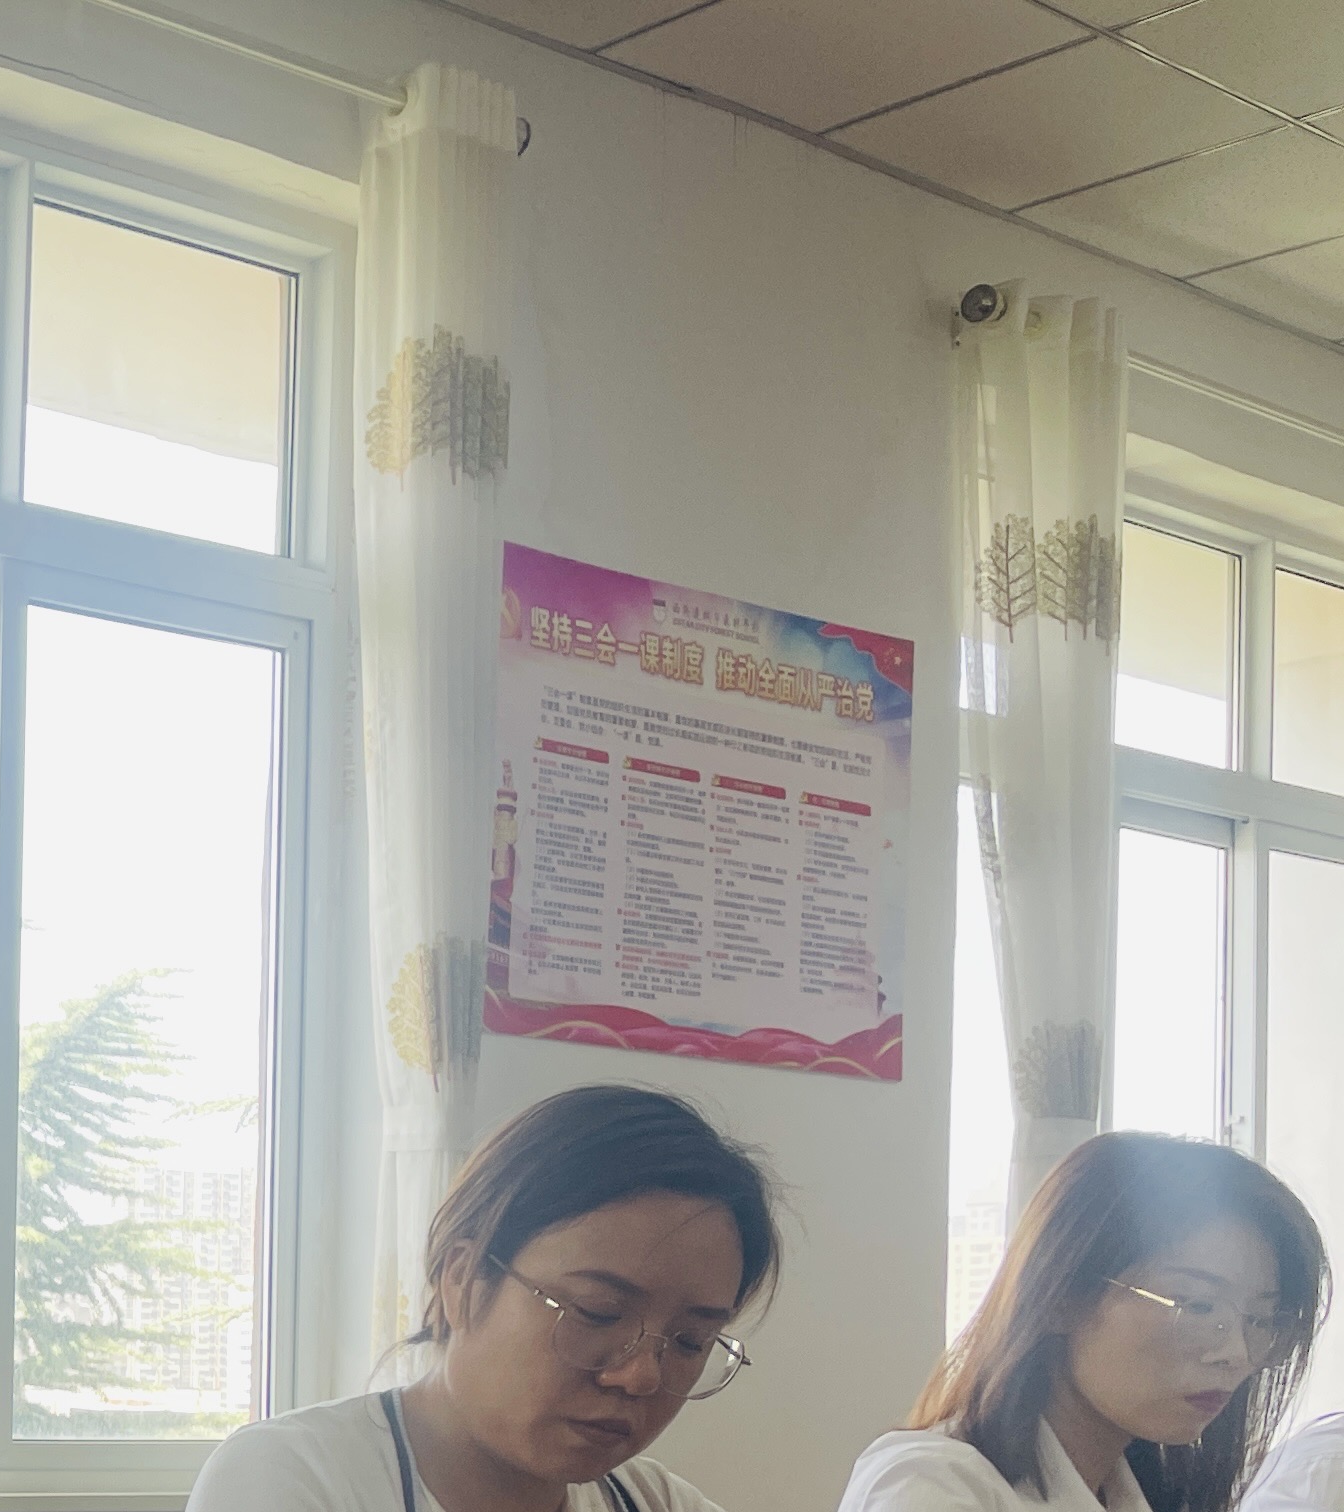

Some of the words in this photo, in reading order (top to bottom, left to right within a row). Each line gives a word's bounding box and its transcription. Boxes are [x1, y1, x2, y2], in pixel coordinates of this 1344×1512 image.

[529, 605, 705, 685] 坚持三会一课制度
[716, 647, 875, 722] 推动全面从严治党
